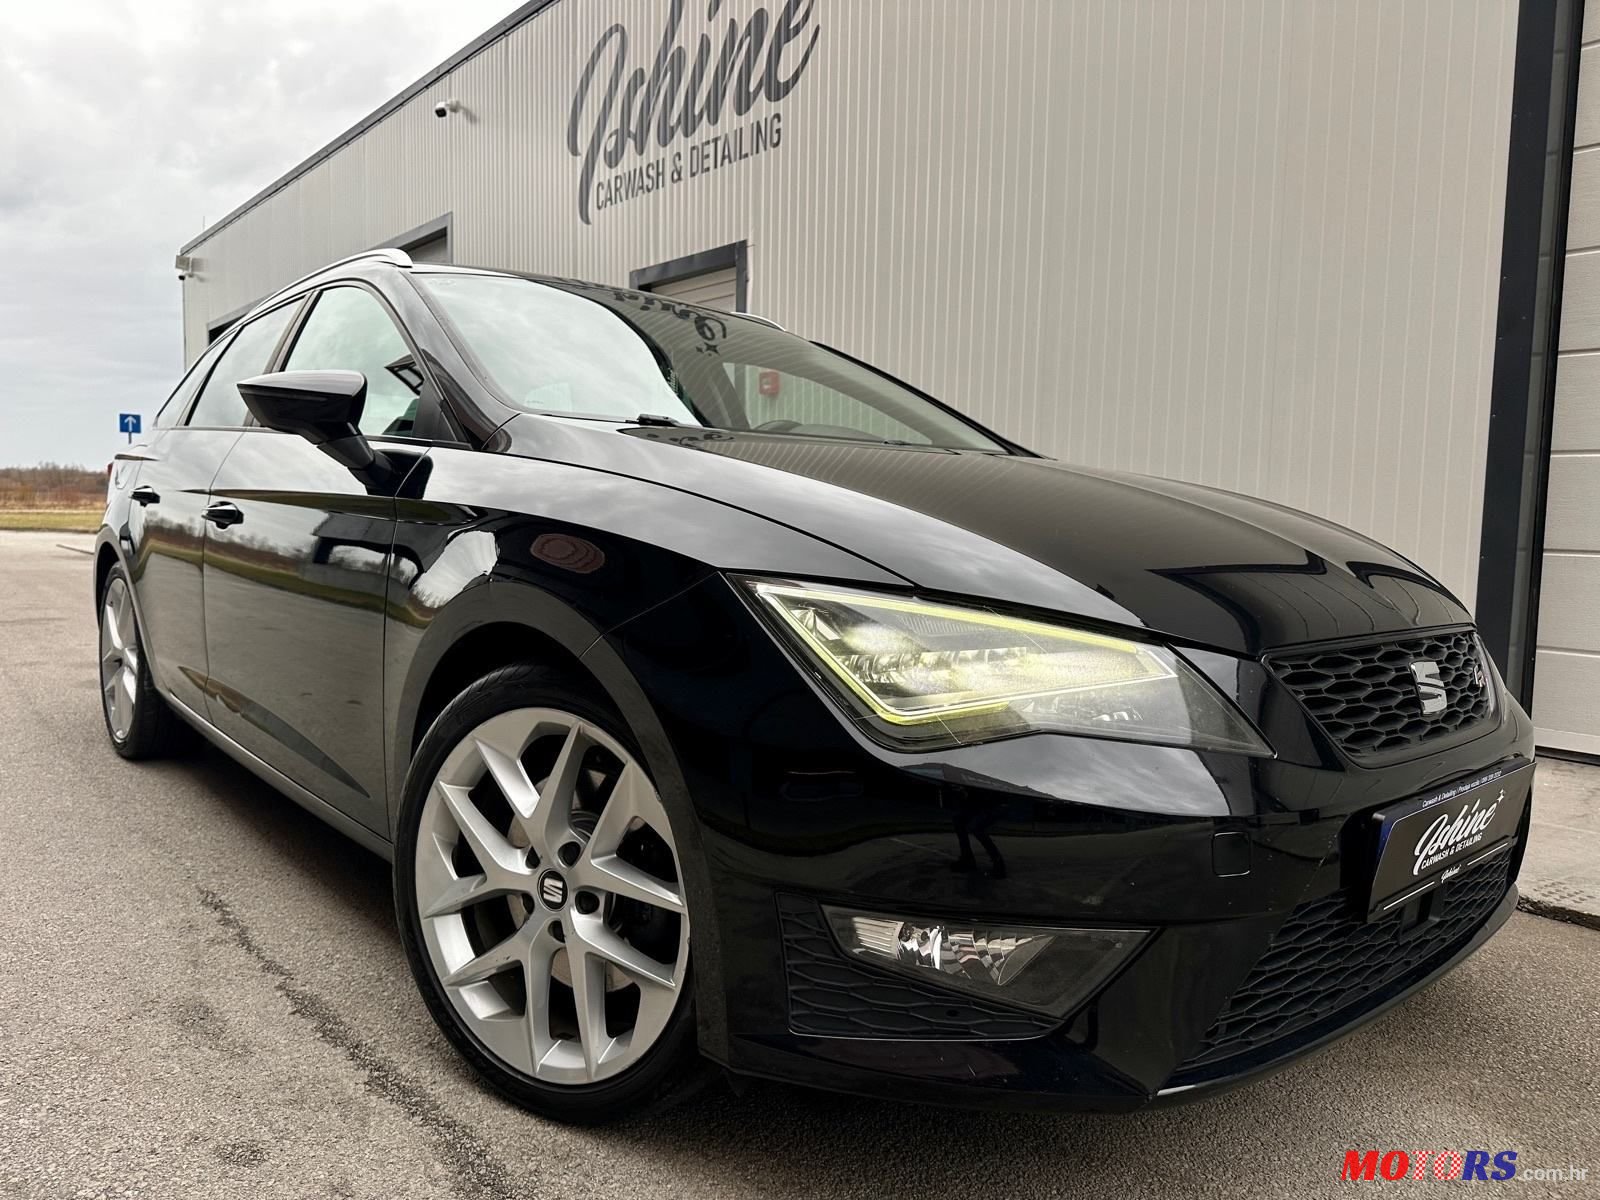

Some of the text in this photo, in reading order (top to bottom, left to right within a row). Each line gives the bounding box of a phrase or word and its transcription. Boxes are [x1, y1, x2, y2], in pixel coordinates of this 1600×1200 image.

[596, 113, 782, 210] CARWASH & DETAILING
[1421, 851, 1450, 869] CARWASH
[1456, 832, 1483, 852] DETAILING
